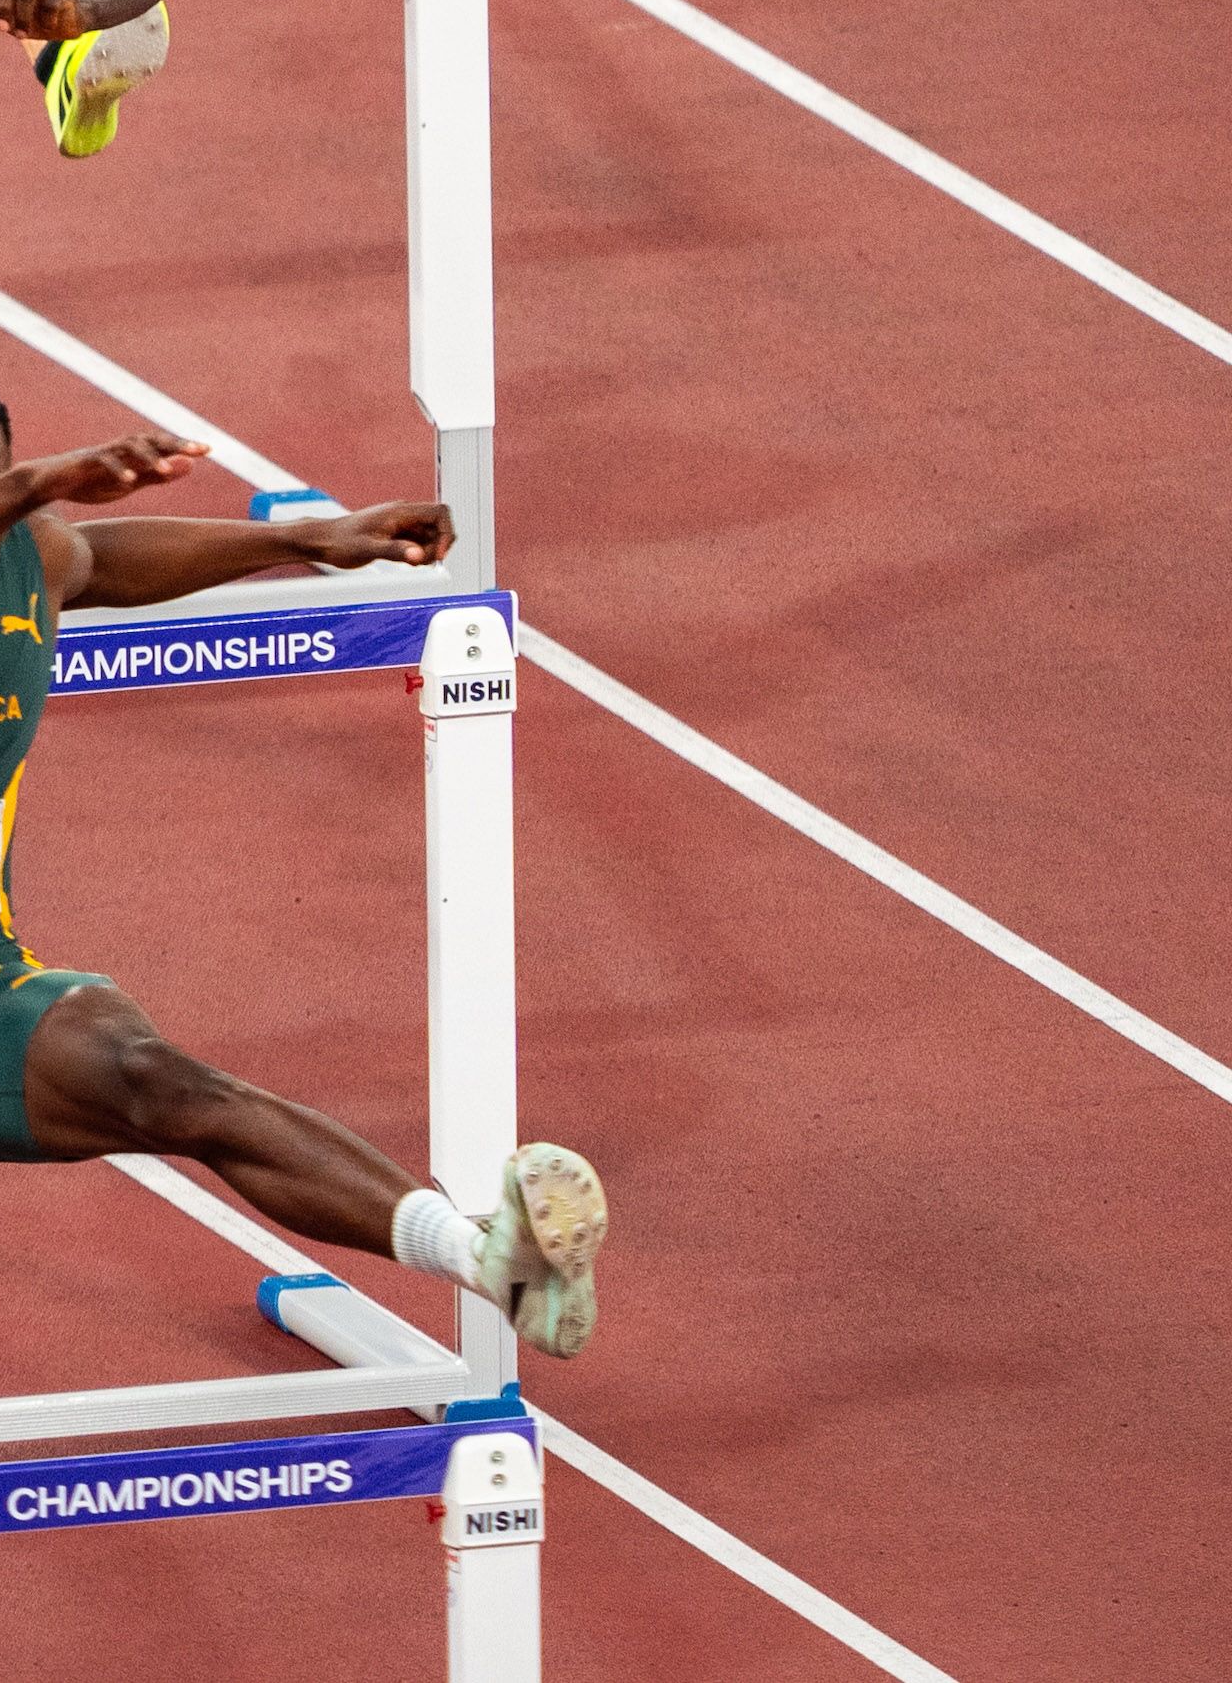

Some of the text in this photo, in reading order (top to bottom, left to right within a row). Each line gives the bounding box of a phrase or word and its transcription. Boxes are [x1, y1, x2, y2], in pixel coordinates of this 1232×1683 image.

[443, 679, 511, 705] NISHI
[7, 1459, 354, 1521] CHAMPIONSHIPS
[465, 1508, 538, 1535] NISHI
